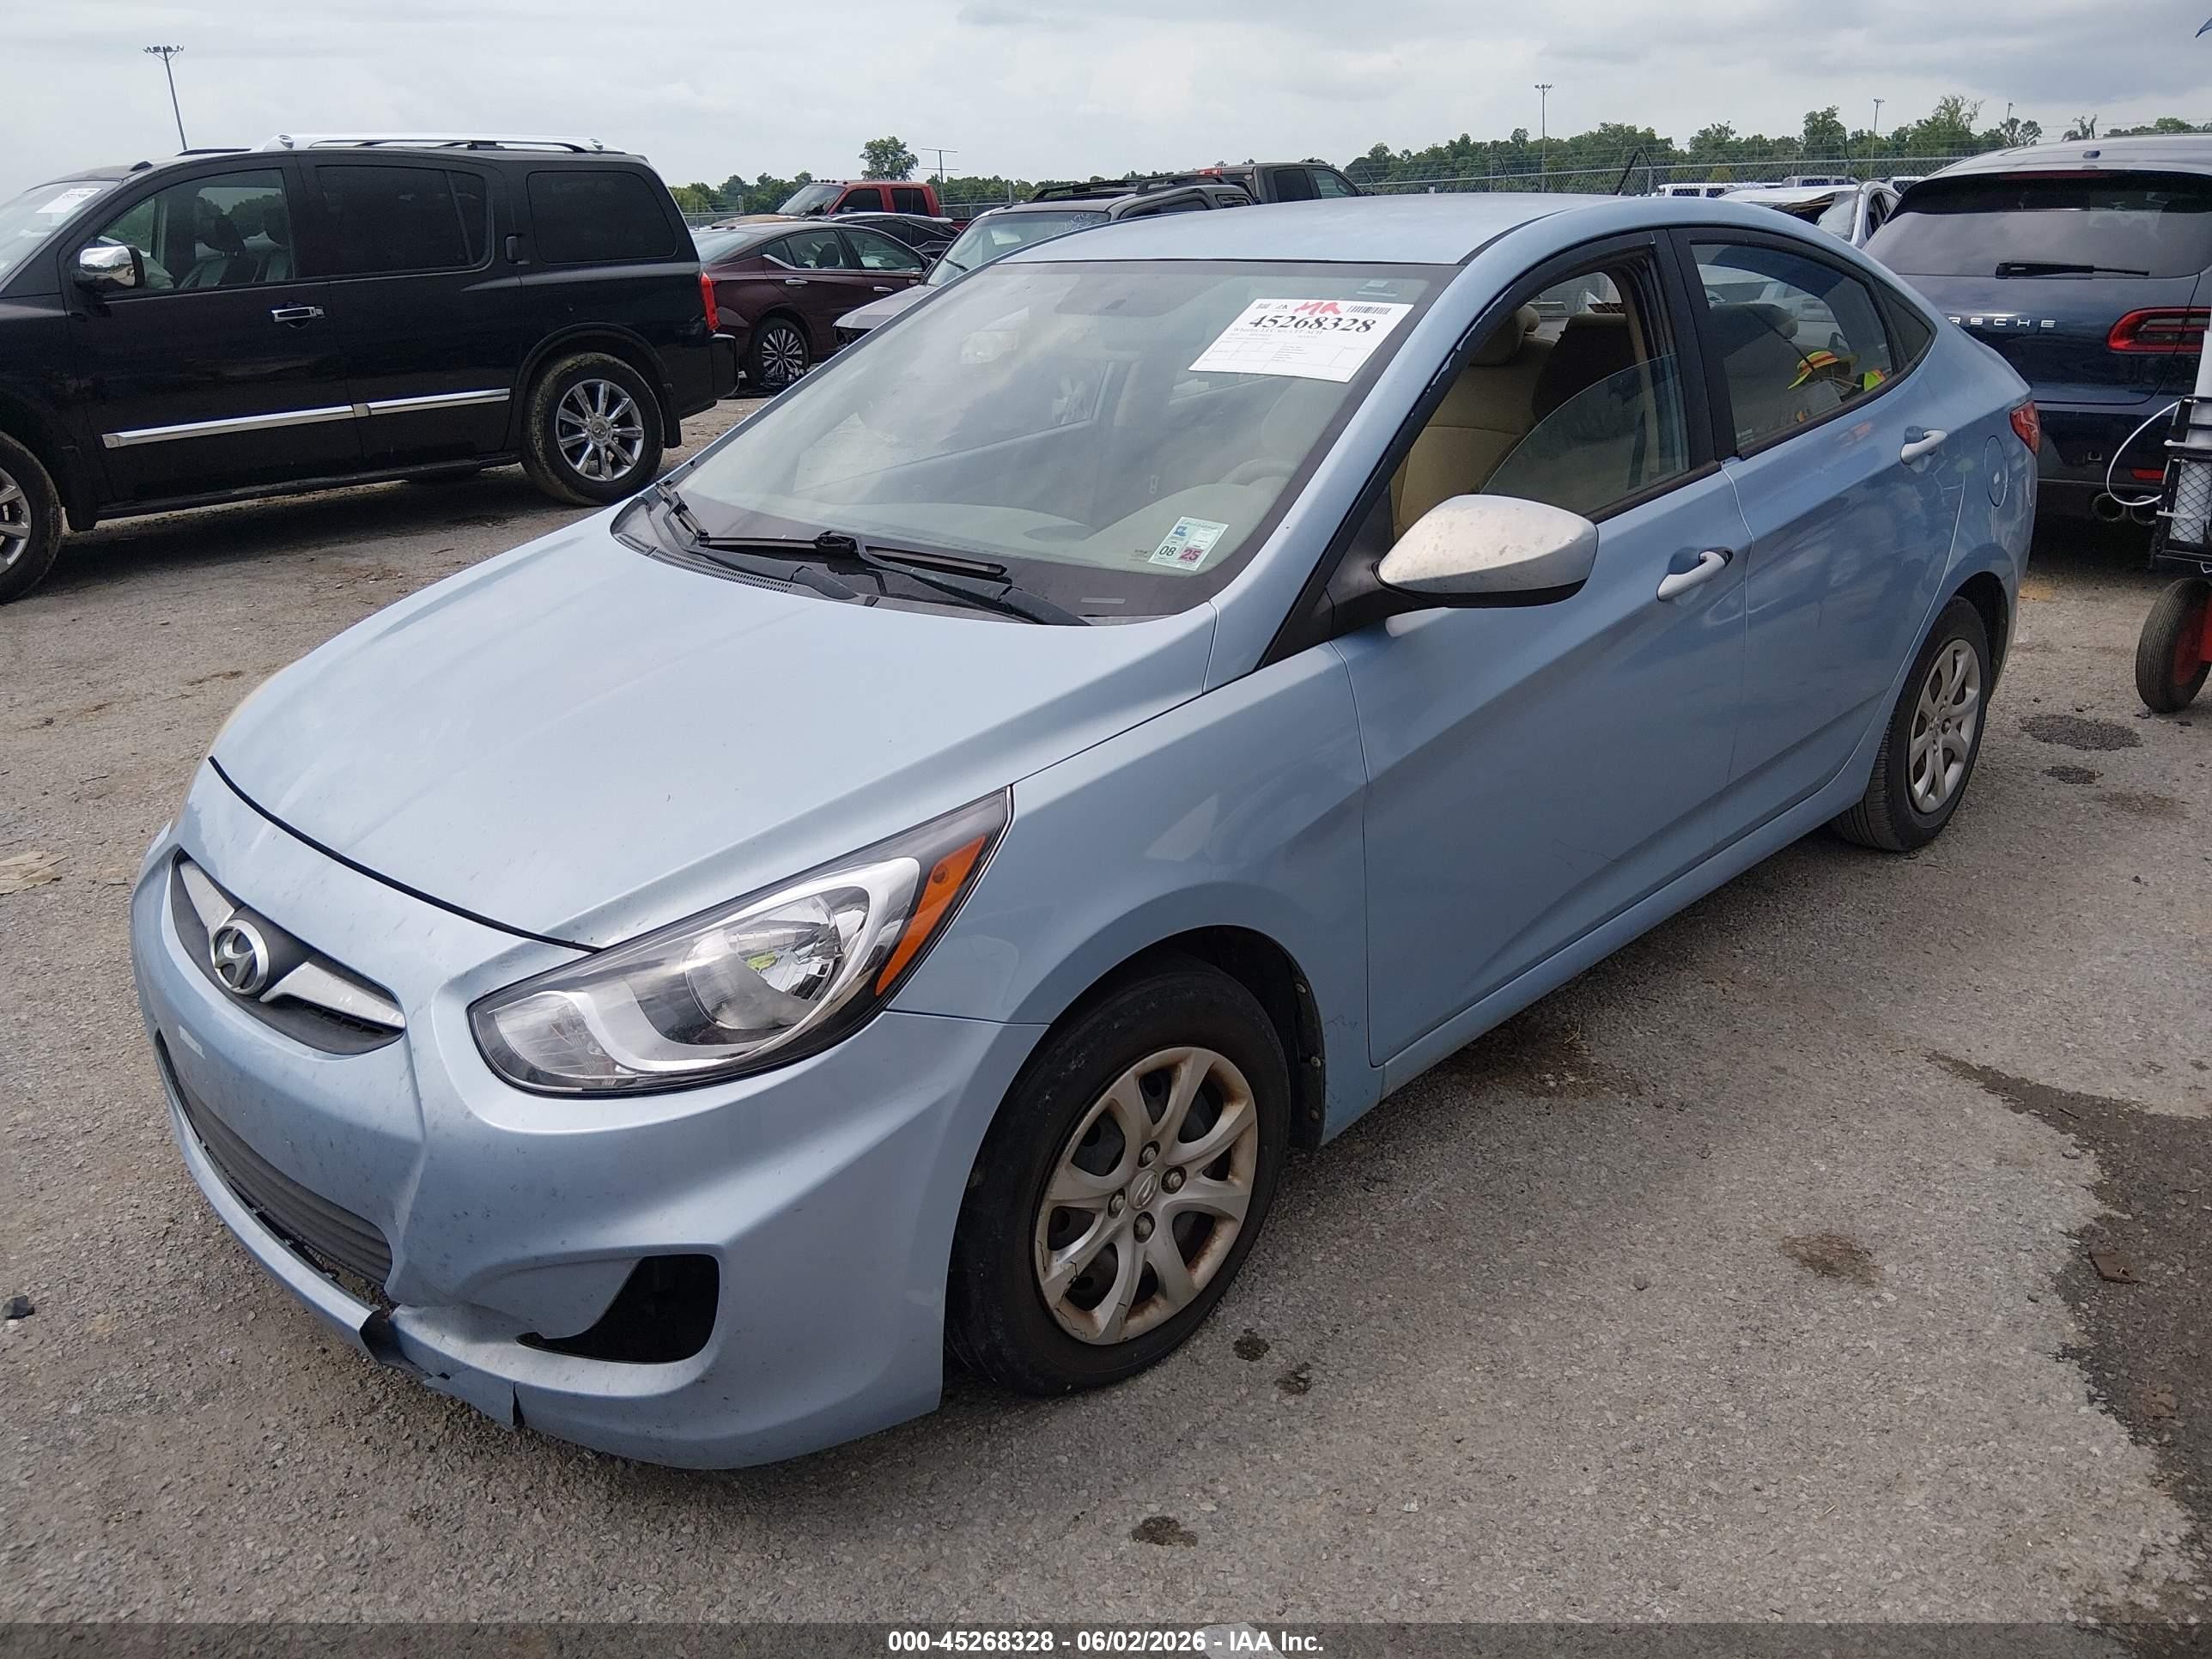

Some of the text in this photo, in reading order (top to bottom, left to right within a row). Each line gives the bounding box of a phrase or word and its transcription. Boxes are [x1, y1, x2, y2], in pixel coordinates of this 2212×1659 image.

[1249, 314, 1376, 333] 45268328
[1159, 545, 1176, 556] 08
[1180, 550, 1200, 561] 25
